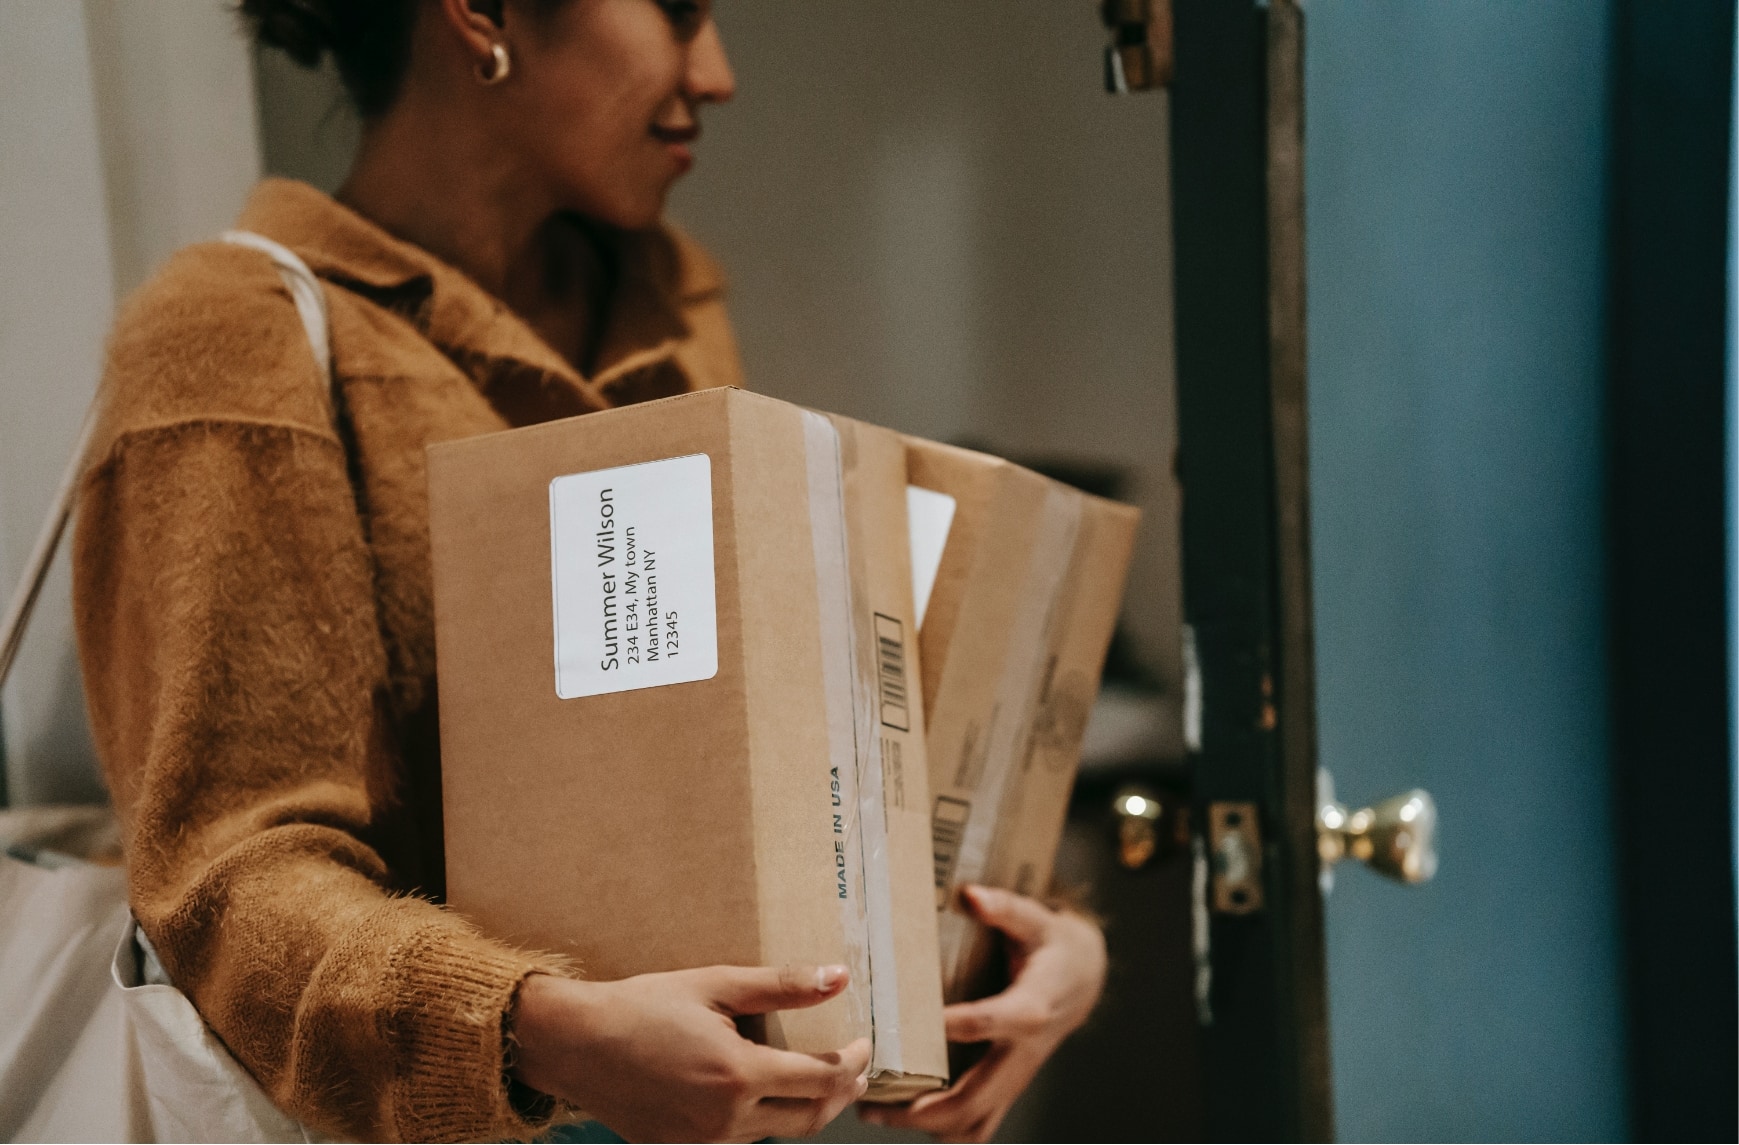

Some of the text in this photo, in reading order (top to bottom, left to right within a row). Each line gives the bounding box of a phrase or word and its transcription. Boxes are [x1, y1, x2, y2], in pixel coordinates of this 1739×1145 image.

[596, 488, 619, 671] Summer Wilson
[625, 527, 640, 665] 234 E34, My town
[644, 549, 659, 662] Manhattan NY
[666, 611, 679, 658] 12345
[830, 766, 848, 899] MADE IN USA
